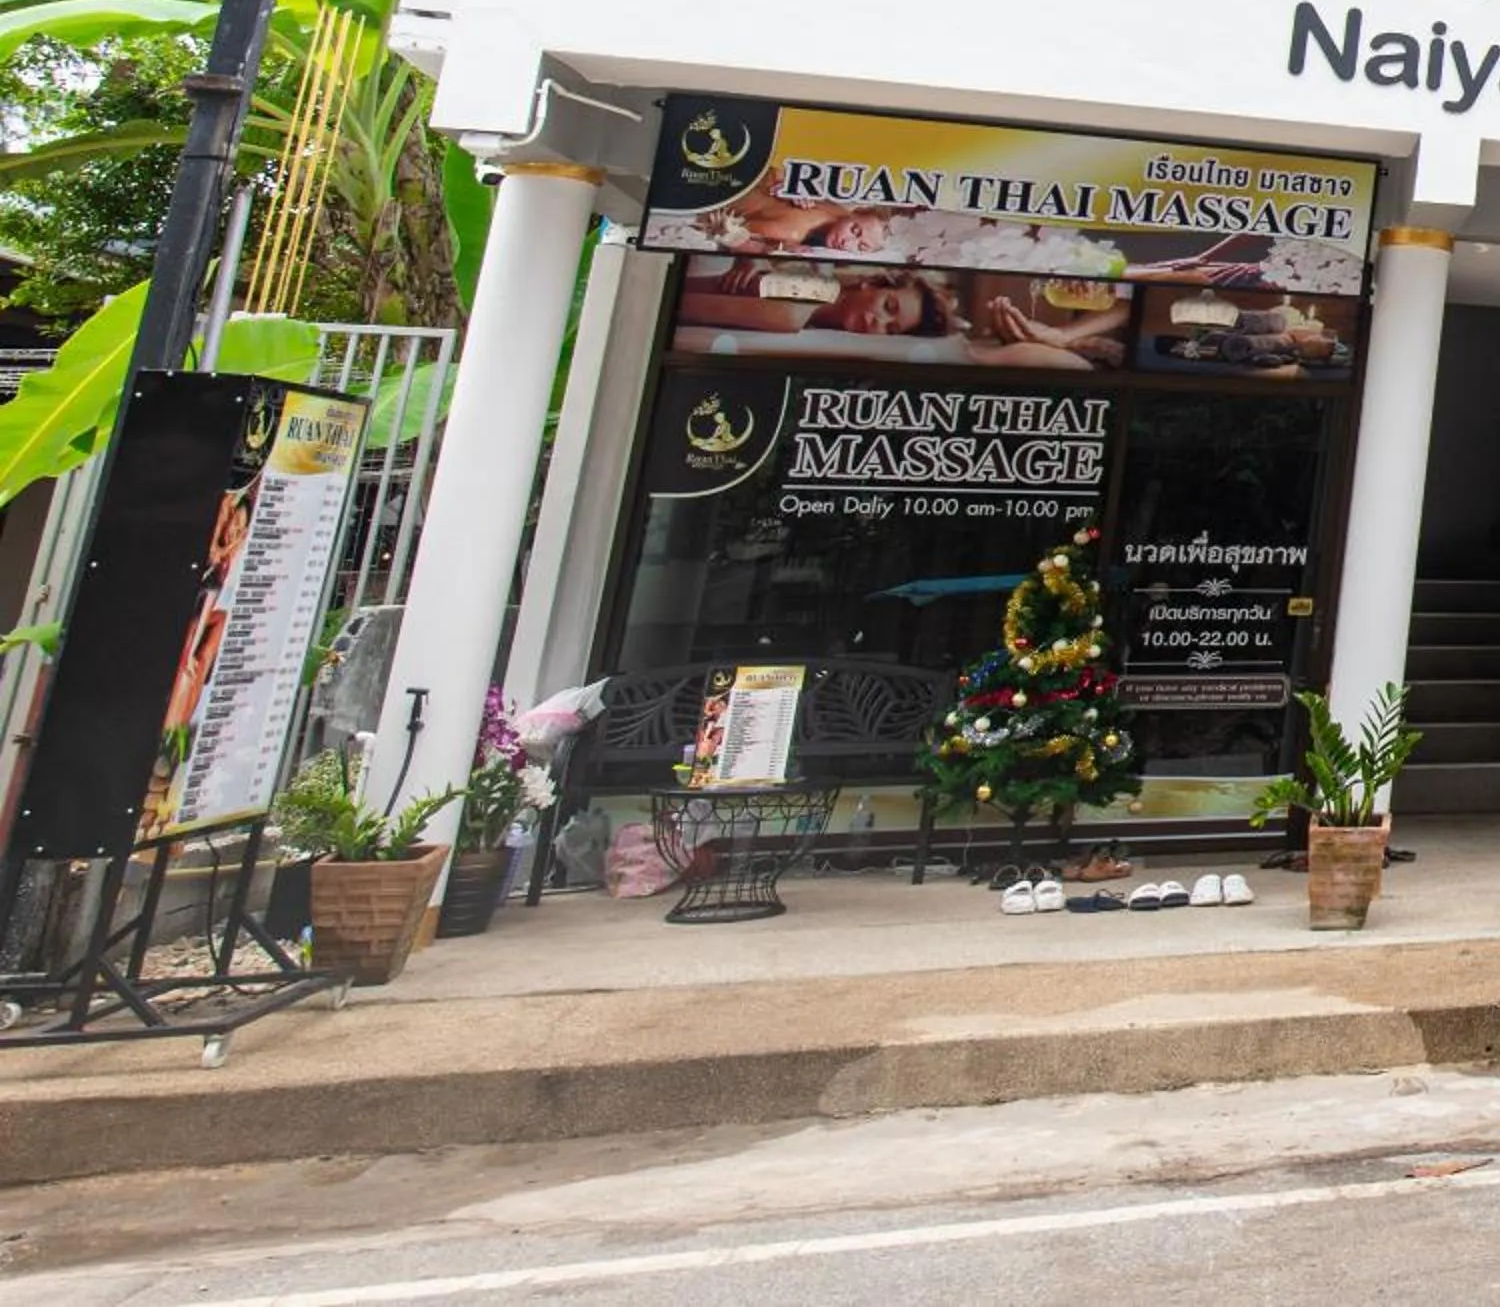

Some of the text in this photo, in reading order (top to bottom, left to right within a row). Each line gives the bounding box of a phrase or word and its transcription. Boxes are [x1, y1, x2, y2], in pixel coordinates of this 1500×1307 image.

[1147, 155, 1352, 197] เรือนไทย มาสซาจ
[786, 160, 1352, 239] RUAN THAI MASSAGE
[799, 389, 1110, 437] RUAN THAI
[788, 433, 1104, 484] MASSAGE
[779, 494, 835, 518] Open
[903, 497, 959, 516] 10.00
[1065, 505, 1095, 522] pm
[1125, 530, 1307, 574] นวดเพื่อสุขภาพ
[1150, 604, 1272, 624] เปิดบริการทุกวัน
[1142, 631, 1249, 647] 10.00-22.00
